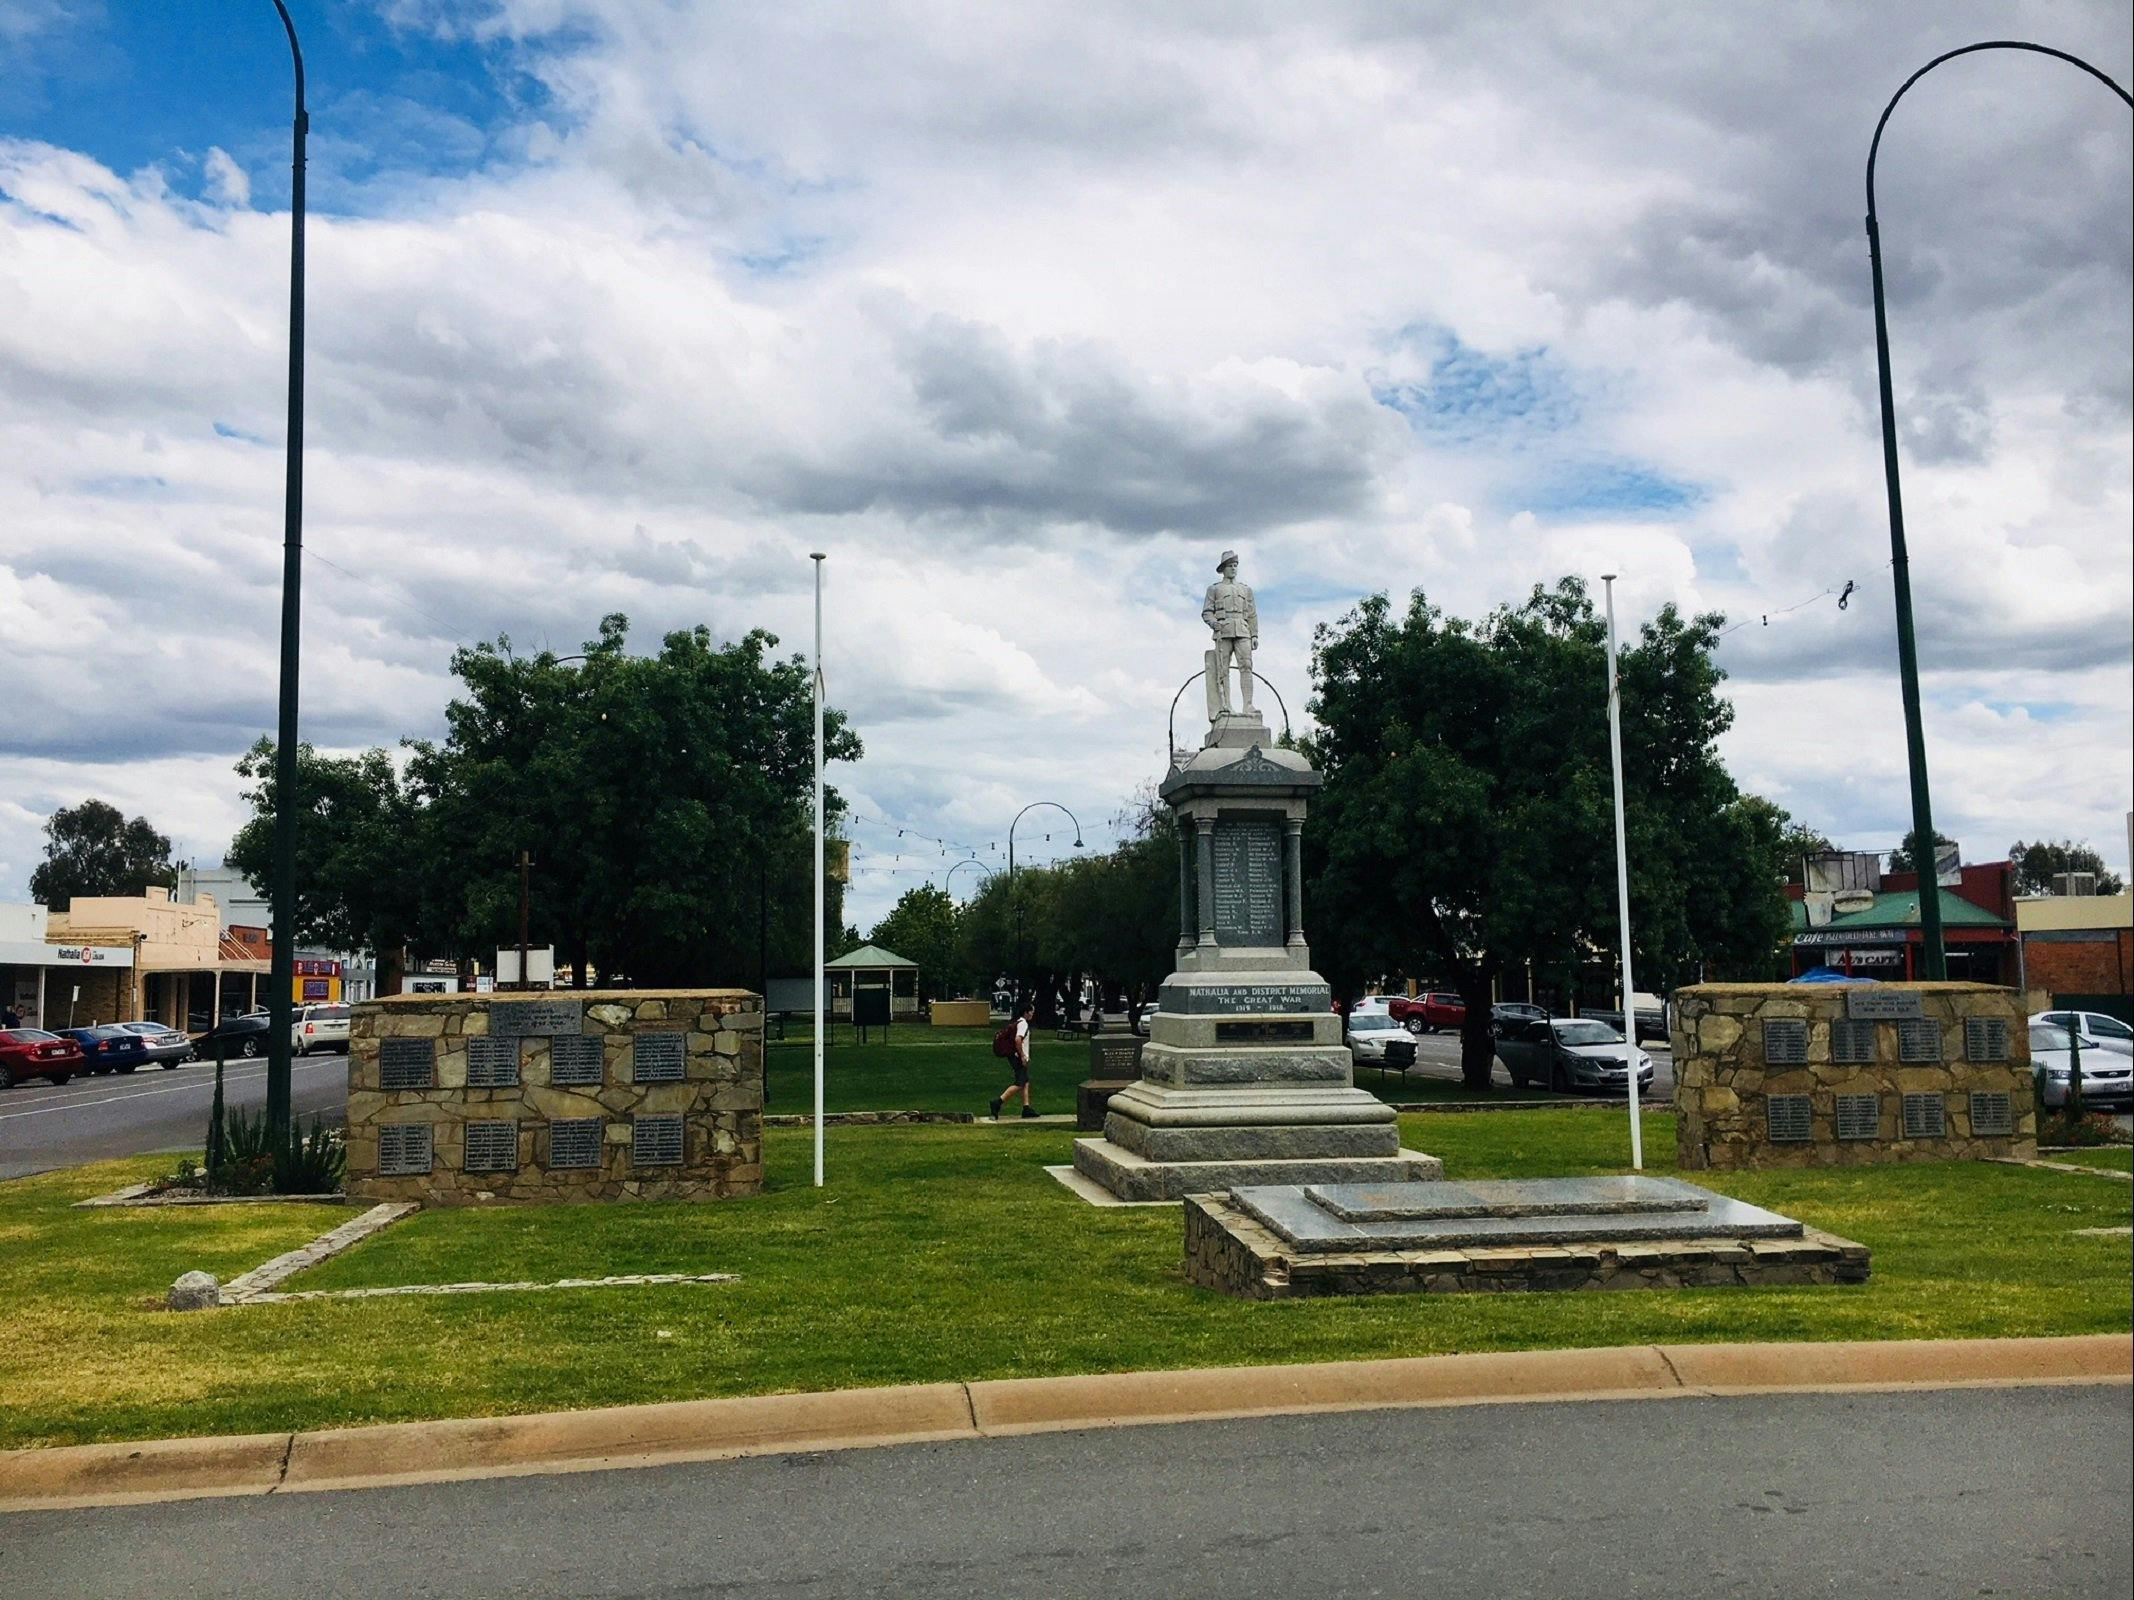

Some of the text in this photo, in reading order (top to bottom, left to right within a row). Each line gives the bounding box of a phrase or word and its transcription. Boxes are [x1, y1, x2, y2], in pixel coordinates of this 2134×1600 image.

[57, 948, 81, 960] Nathalia
[1189, 986, 1330, 996] NATHALIA AND DISTRICT MEMORIAL
[1218, 996, 1236, 1004] THE
[1243, 996, 1274, 1004] GREAT
